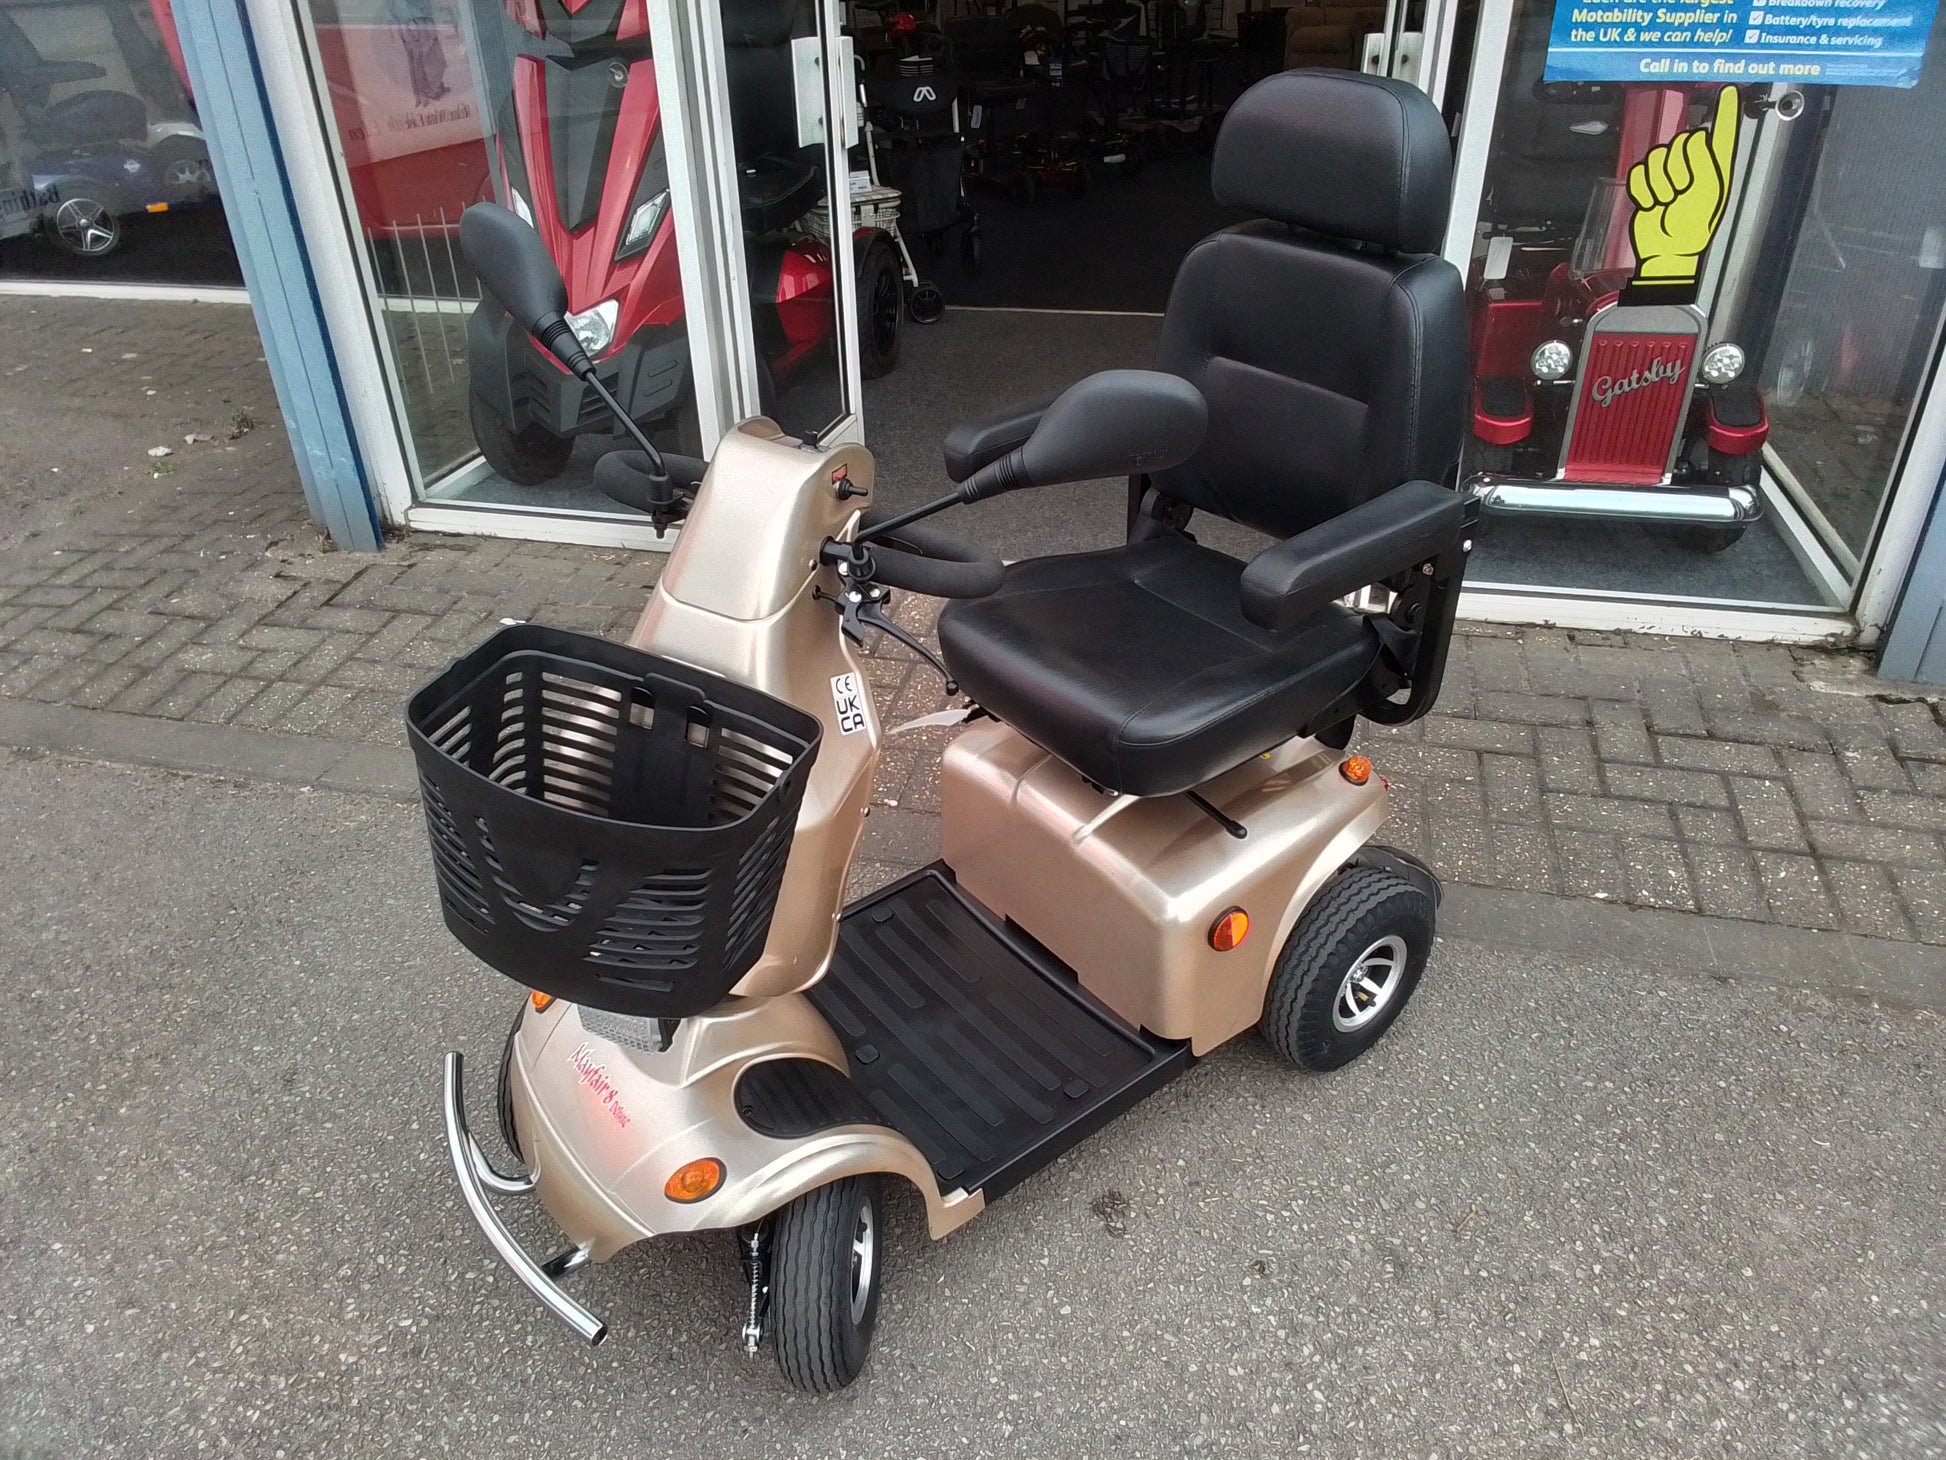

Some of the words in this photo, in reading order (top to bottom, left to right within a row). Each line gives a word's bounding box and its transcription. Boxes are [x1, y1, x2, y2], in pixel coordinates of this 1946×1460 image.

[1834, 0, 1887, 10] recovery
[1572, 9, 1652, 26] Motability
[1656, 8, 1721, 26] Supplier
[1723, 10, 1738, 23] in
[1764, 14, 1836, 28] Battery/tyre
[1571, 28, 1596, 41] the
[1599, 28, 1622, 41] UK
[1624, 28, 1637, 41] &
[1640, 31, 1660, 42] we
[1663, 31, 1691, 42] can
[1694, 28, 1733, 45] help!
[1760, 33, 1817, 45] Insurance
[1818, 34, 1830, 44] &
[1830, 34, 1884, 48] servicing
[1639, 58, 1670, 73] Call
[1673, 59, 1688, 73] in
[1692, 60, 1709, 74] to
[1713, 59, 1745, 74] find
[1748, 62, 1775, 75] out
[1778, 63, 1821, 76] more
[1591, 356, 1686, 408] Gatsby
[836, 694, 860, 715] UK
[840, 712, 865, 733] CA
[567, 1041, 611, 1096] Mayfair
[602, 1088, 619, 1104] 8
